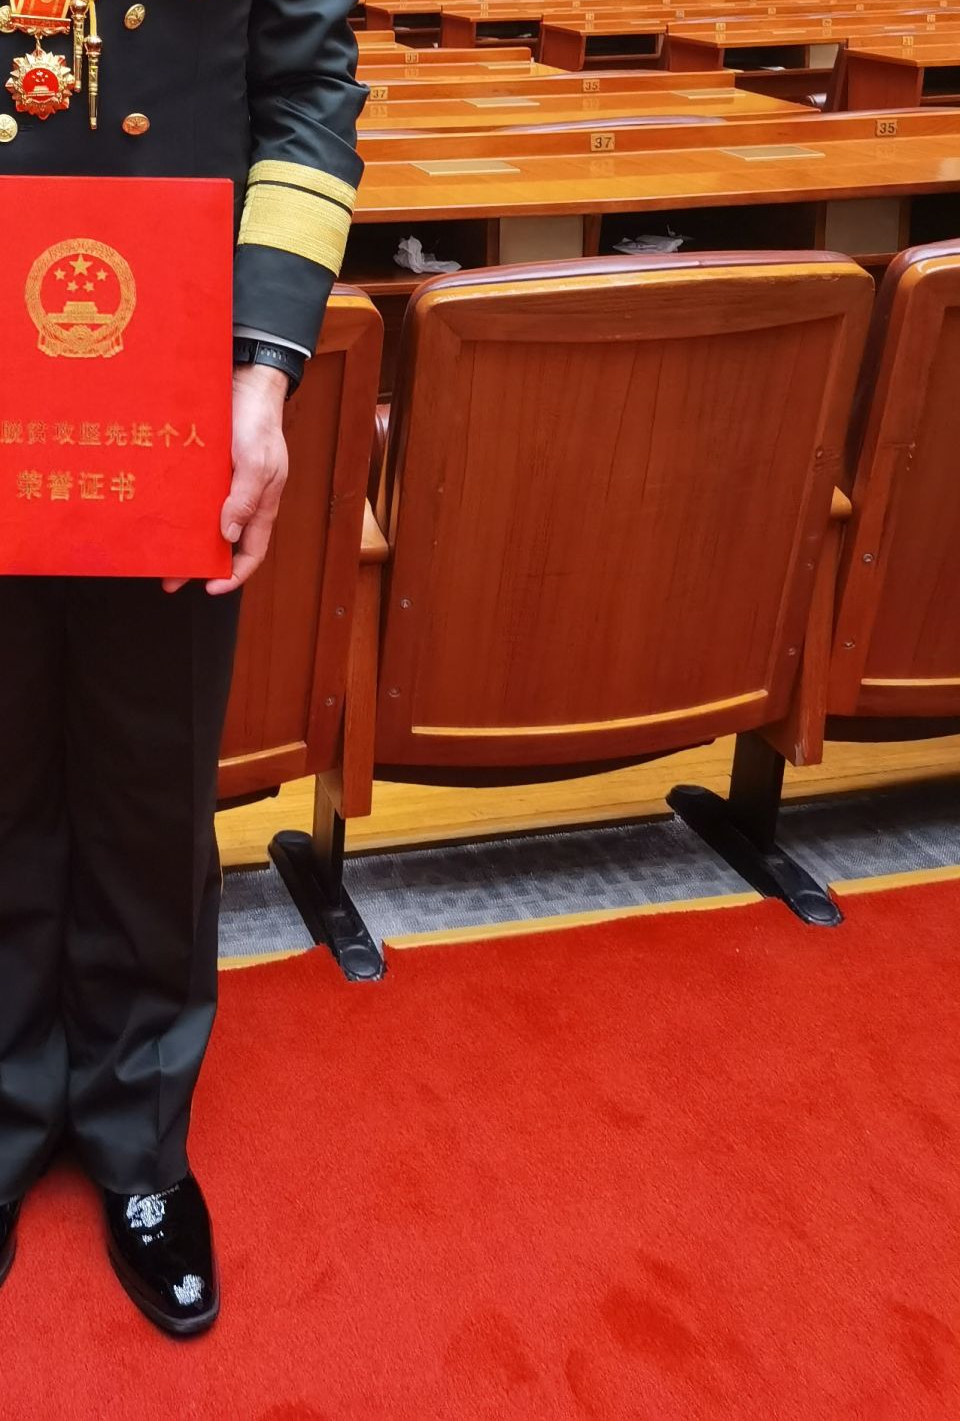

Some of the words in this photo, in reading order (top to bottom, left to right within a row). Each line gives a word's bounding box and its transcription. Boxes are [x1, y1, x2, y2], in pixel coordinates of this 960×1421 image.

[585, 80, 598, 91] 35
[372, 88, 386, 99] 37
[878, 121, 896, 135] 35
[593, 136, 613, 150] 37
[16, 470, 136, 502] 荣誉证书
